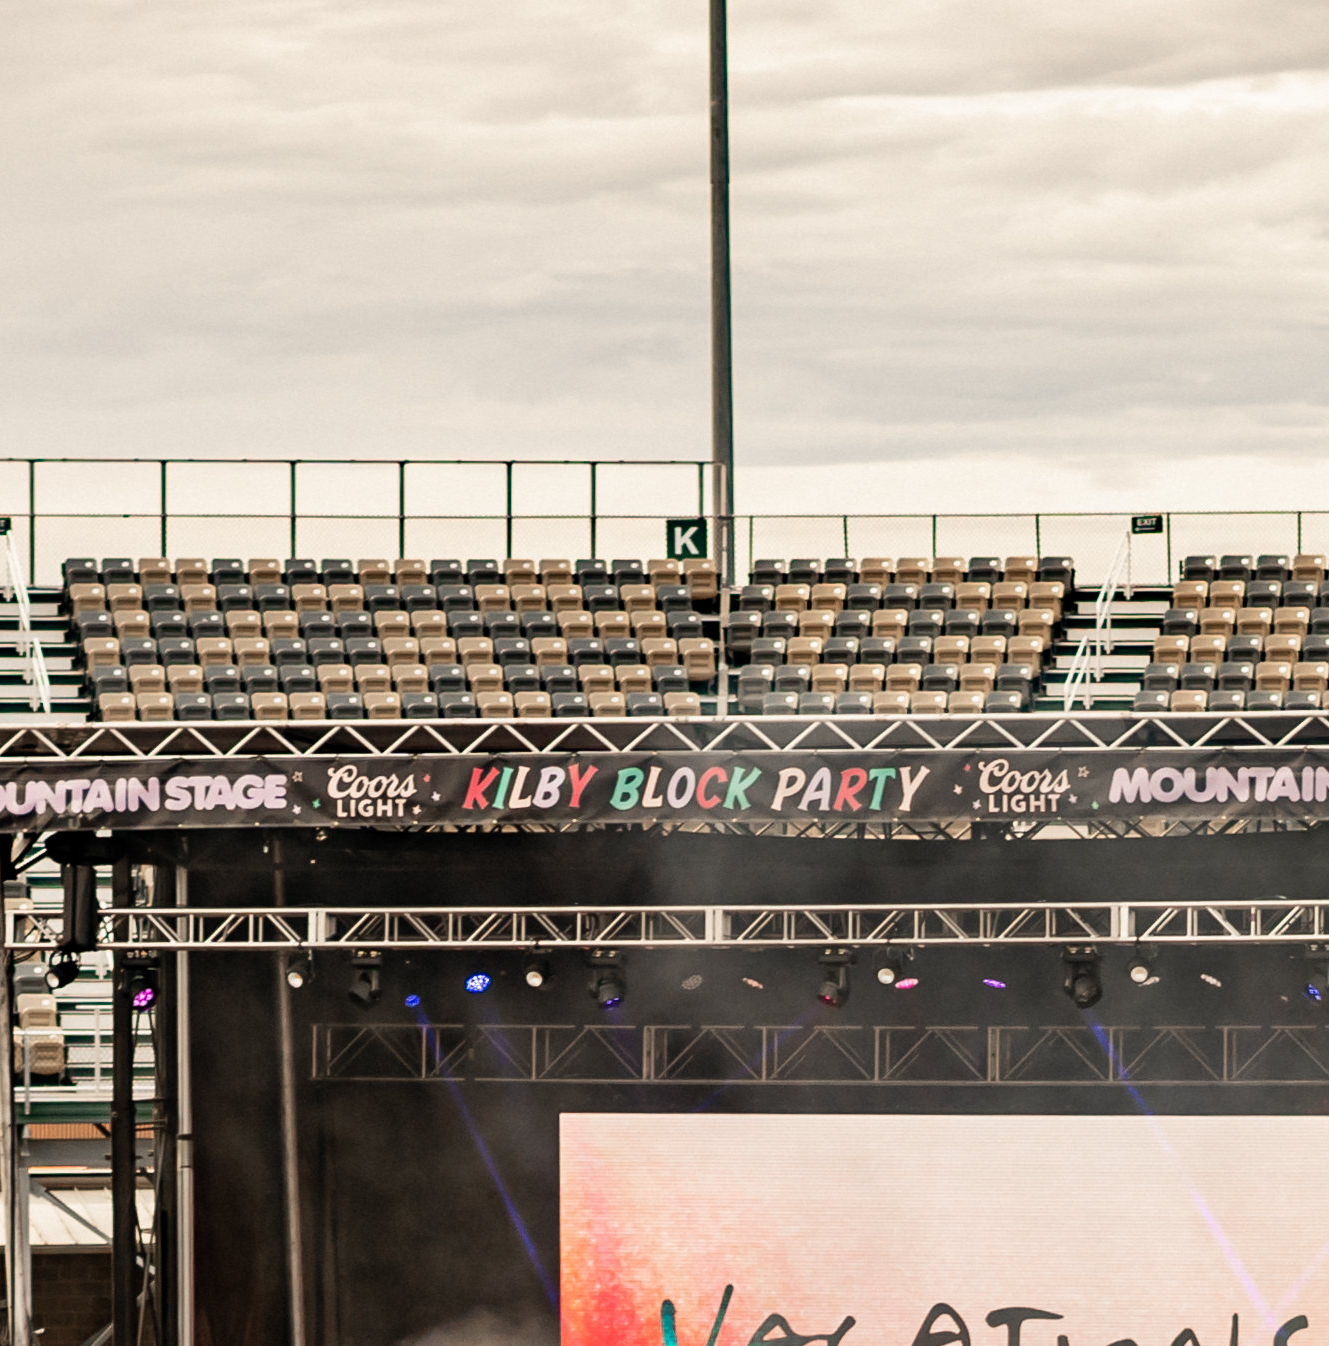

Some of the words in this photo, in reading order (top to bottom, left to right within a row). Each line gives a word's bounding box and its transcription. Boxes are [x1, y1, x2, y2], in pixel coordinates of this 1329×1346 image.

[673, 526, 700, 555] K
[164, 773, 288, 813] STAGE
[326, 764, 418, 801] Coors
[461, 764, 599, 811] KILBY
[610, 765, 763, 812] BLOCK
[770, 765, 931, 812] PARTY
[977, 758, 1072, 796] Coors
[336, 797, 409, 818] LIGHT
[988, 793, 1060, 813] LIGHT
